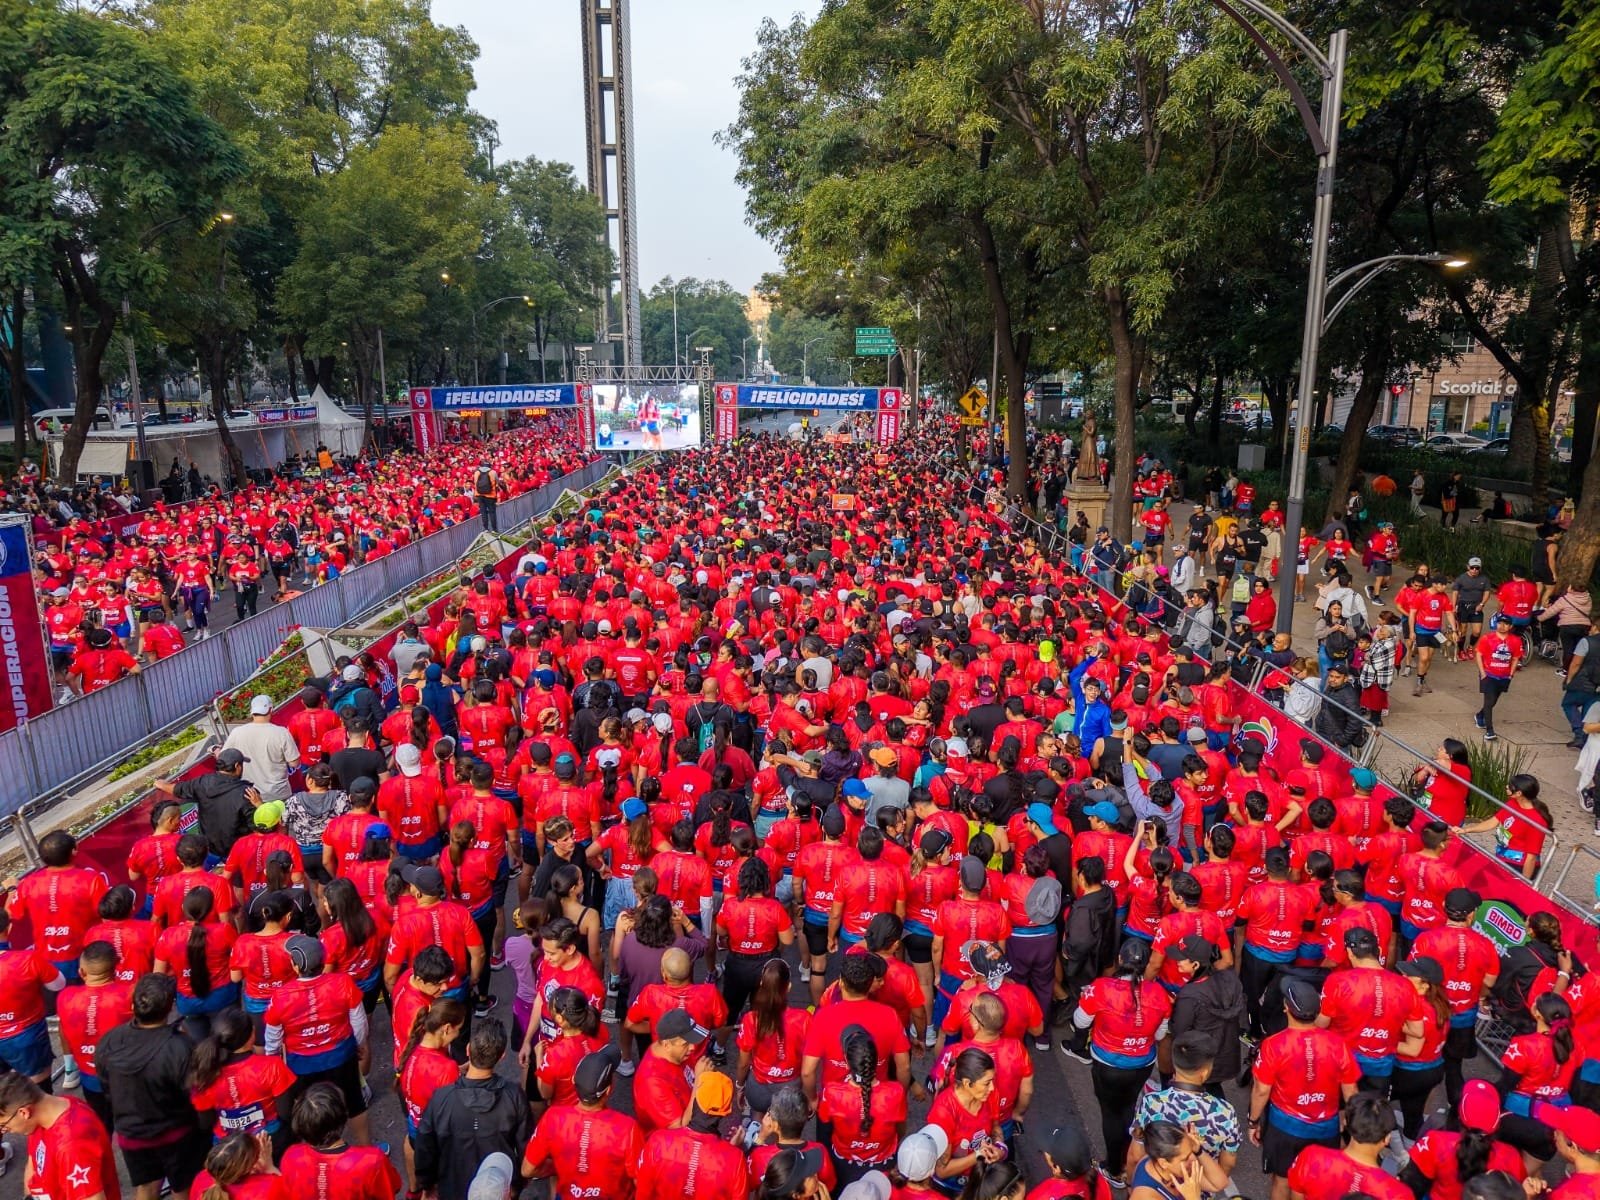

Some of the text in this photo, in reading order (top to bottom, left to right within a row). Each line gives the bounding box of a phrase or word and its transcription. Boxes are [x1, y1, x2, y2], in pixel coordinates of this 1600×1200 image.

[445, 388, 562, 406] ¡FELICIDADES!
[751, 390, 866, 407] ¡FELICIDADES!
[1487, 909, 1523, 941] BIMBO
[1446, 981, 1471, 992] 20-26
[1360, 1027, 1389, 1039] 20-26
[768, 1067, 794, 1078] 20-26
[1297, 1092, 1326, 1105] 20-26
[570, 1184, 600, 1198] 20-26
